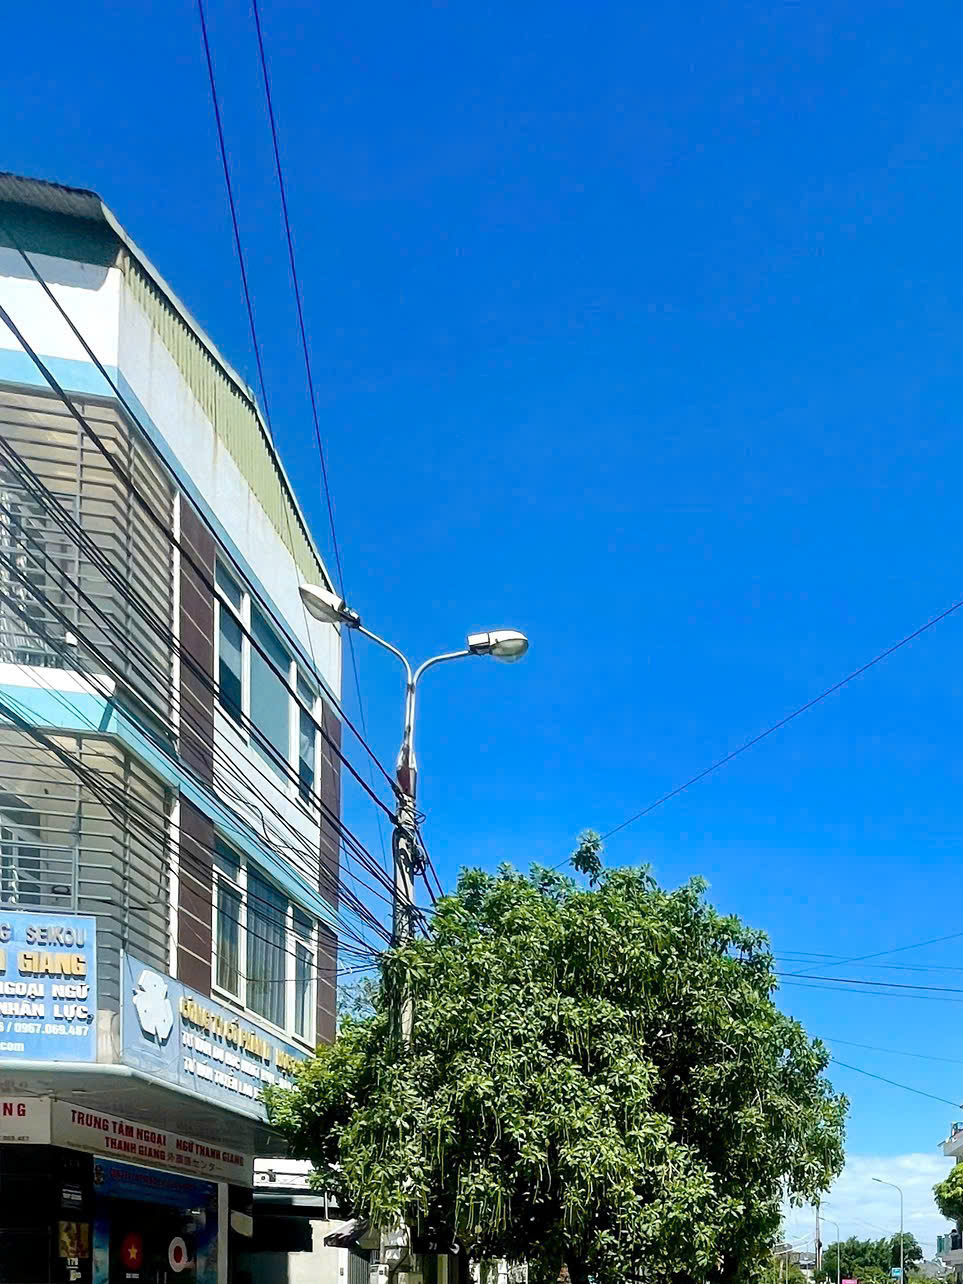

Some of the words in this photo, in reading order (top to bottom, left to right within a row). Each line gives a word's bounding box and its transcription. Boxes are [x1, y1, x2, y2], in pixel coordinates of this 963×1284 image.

[26, 924, 85, 948] SEIKOU
[18, 952, 87, 981] GIANG
[71, 1109, 109, 1131] TRUNG
[111, 1120, 134, 1138] TÂM
[136, 1129, 167, 1149] NGOẠI
[195, 1144, 221, 1160] THANH
[105, 1136, 137, 1154] THANH
[138, 1145, 165, 1161] GIANG
